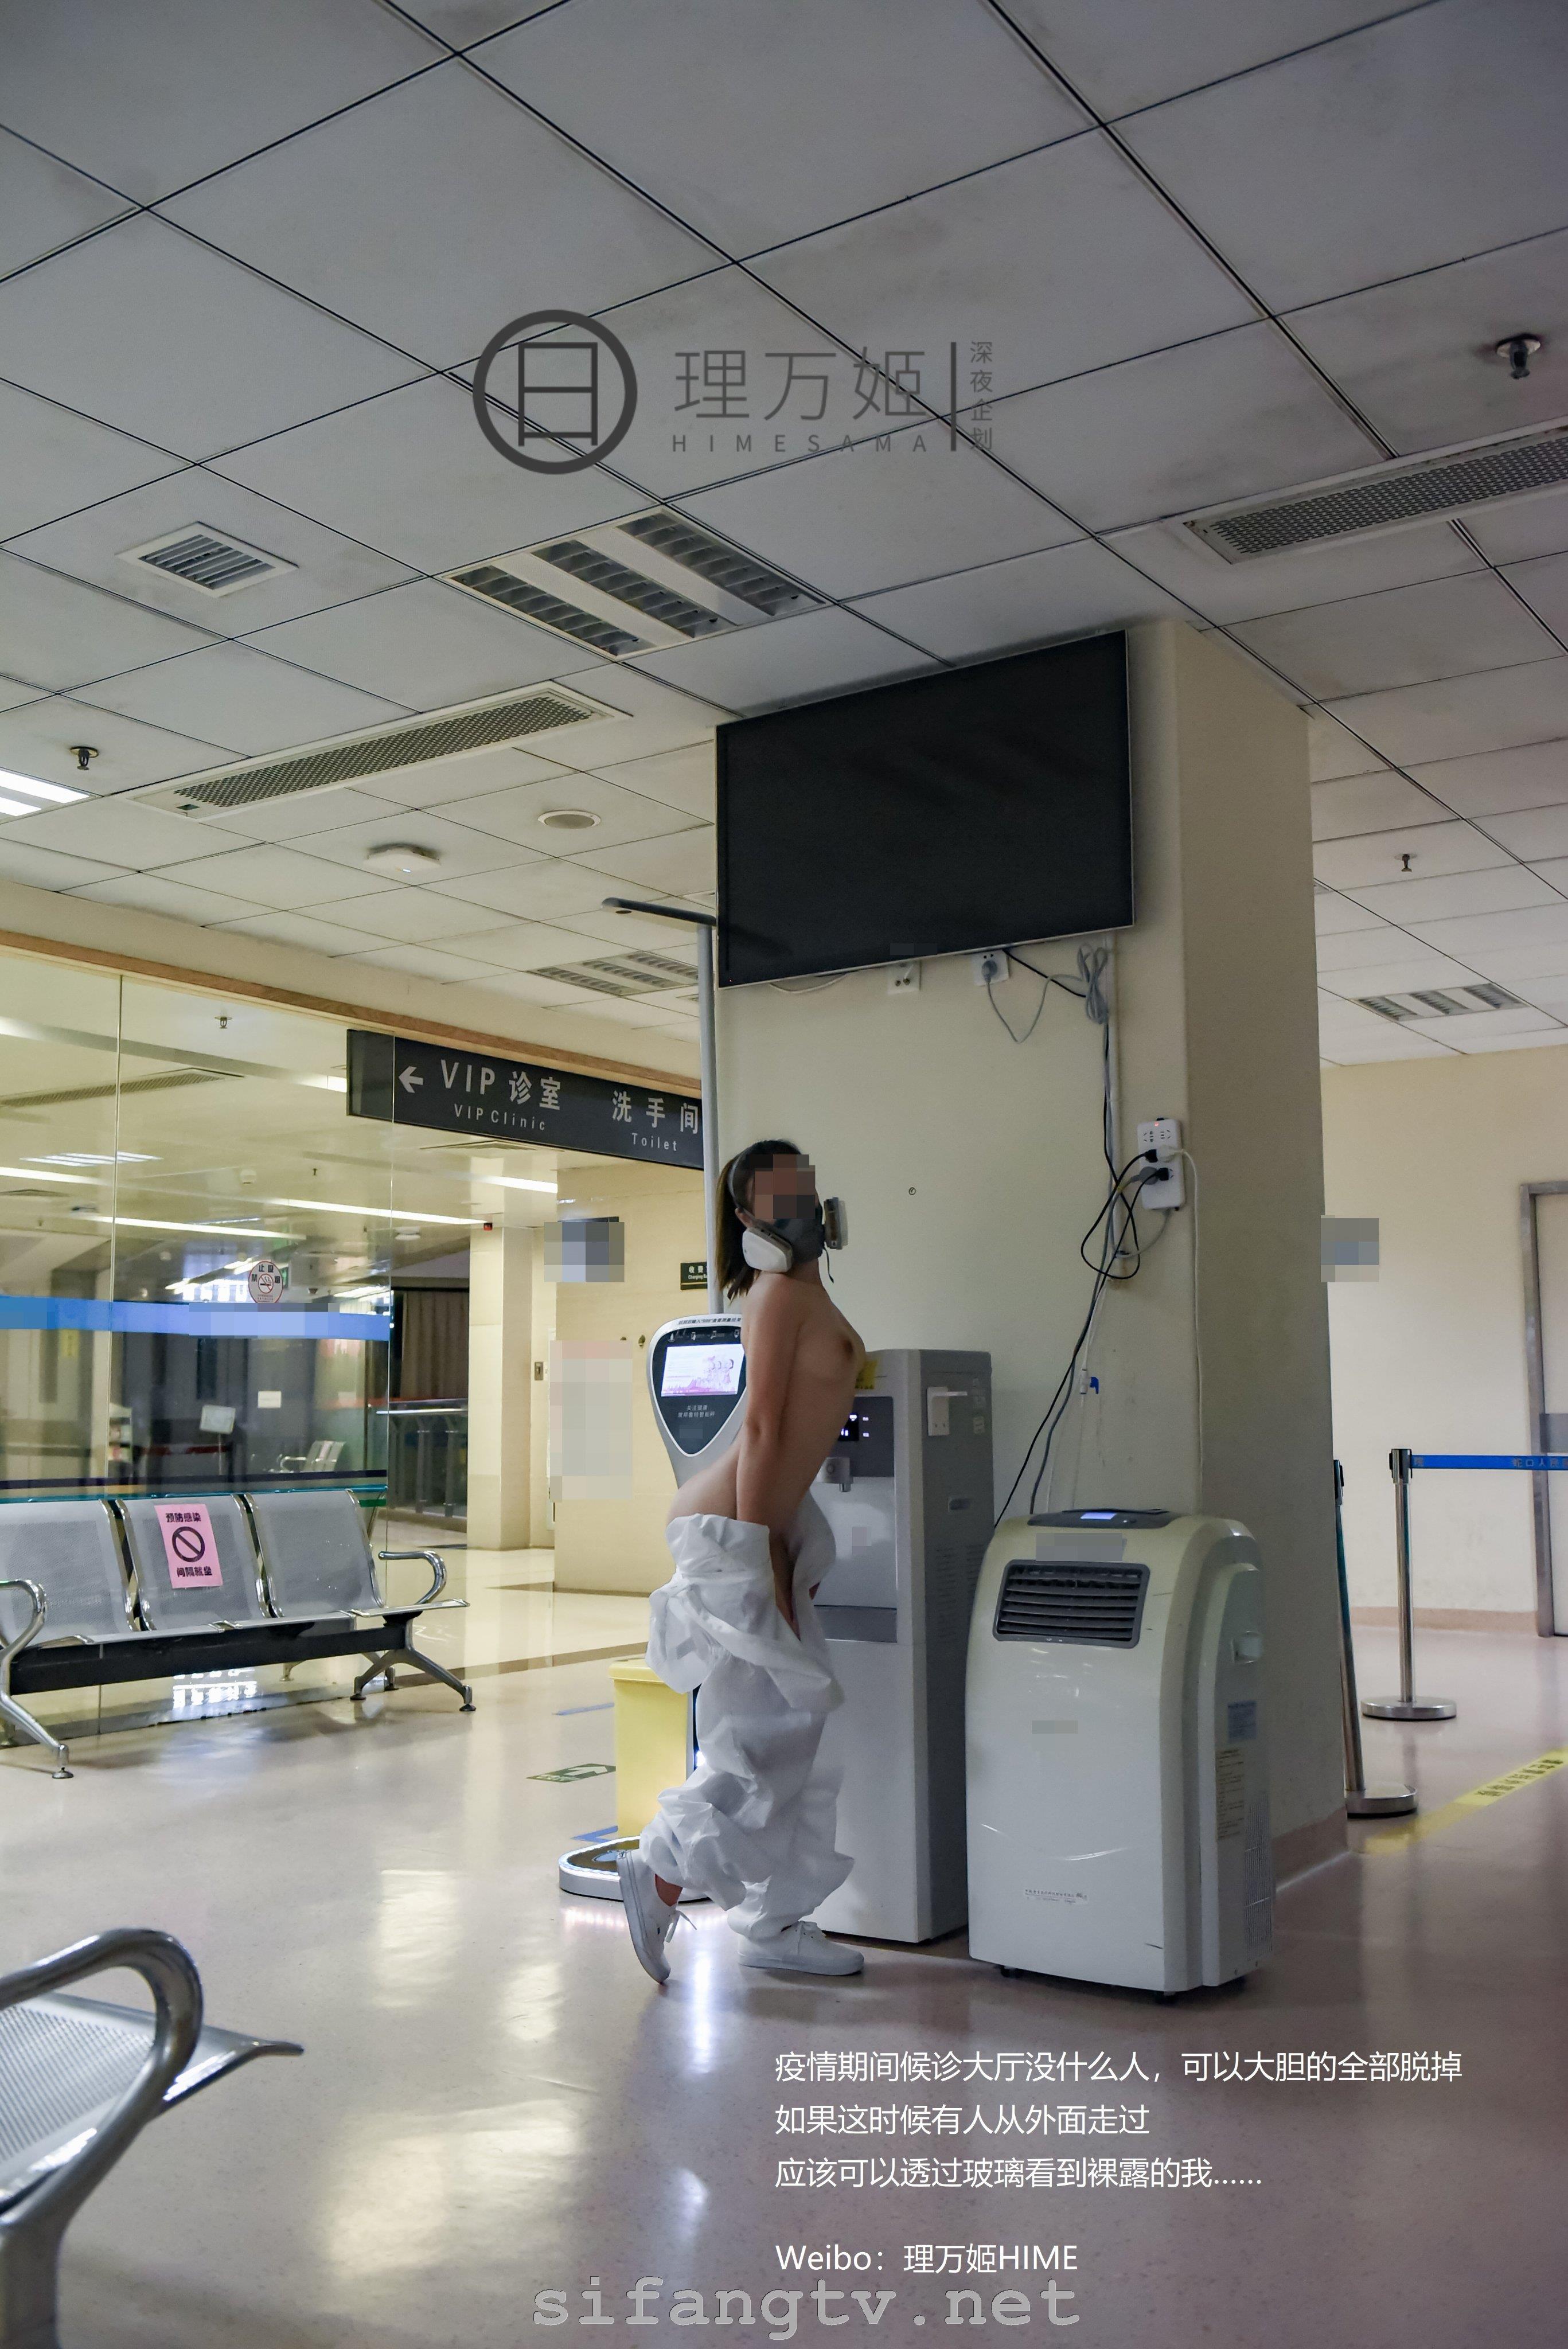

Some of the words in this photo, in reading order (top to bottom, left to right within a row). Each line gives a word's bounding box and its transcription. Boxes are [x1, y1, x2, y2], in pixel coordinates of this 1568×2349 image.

[440, 1059, 496, 1095] VIP
[509, 1071, 561, 1111] 诊室
[454, 1104, 483, 1121] VIP
[491, 1110, 546, 1131] Clinic
[612, 1090, 699, 1135] 洗手间
[631, 1133, 677, 1152] Toilet
[165, 1512, 201, 1523] 预防感染
